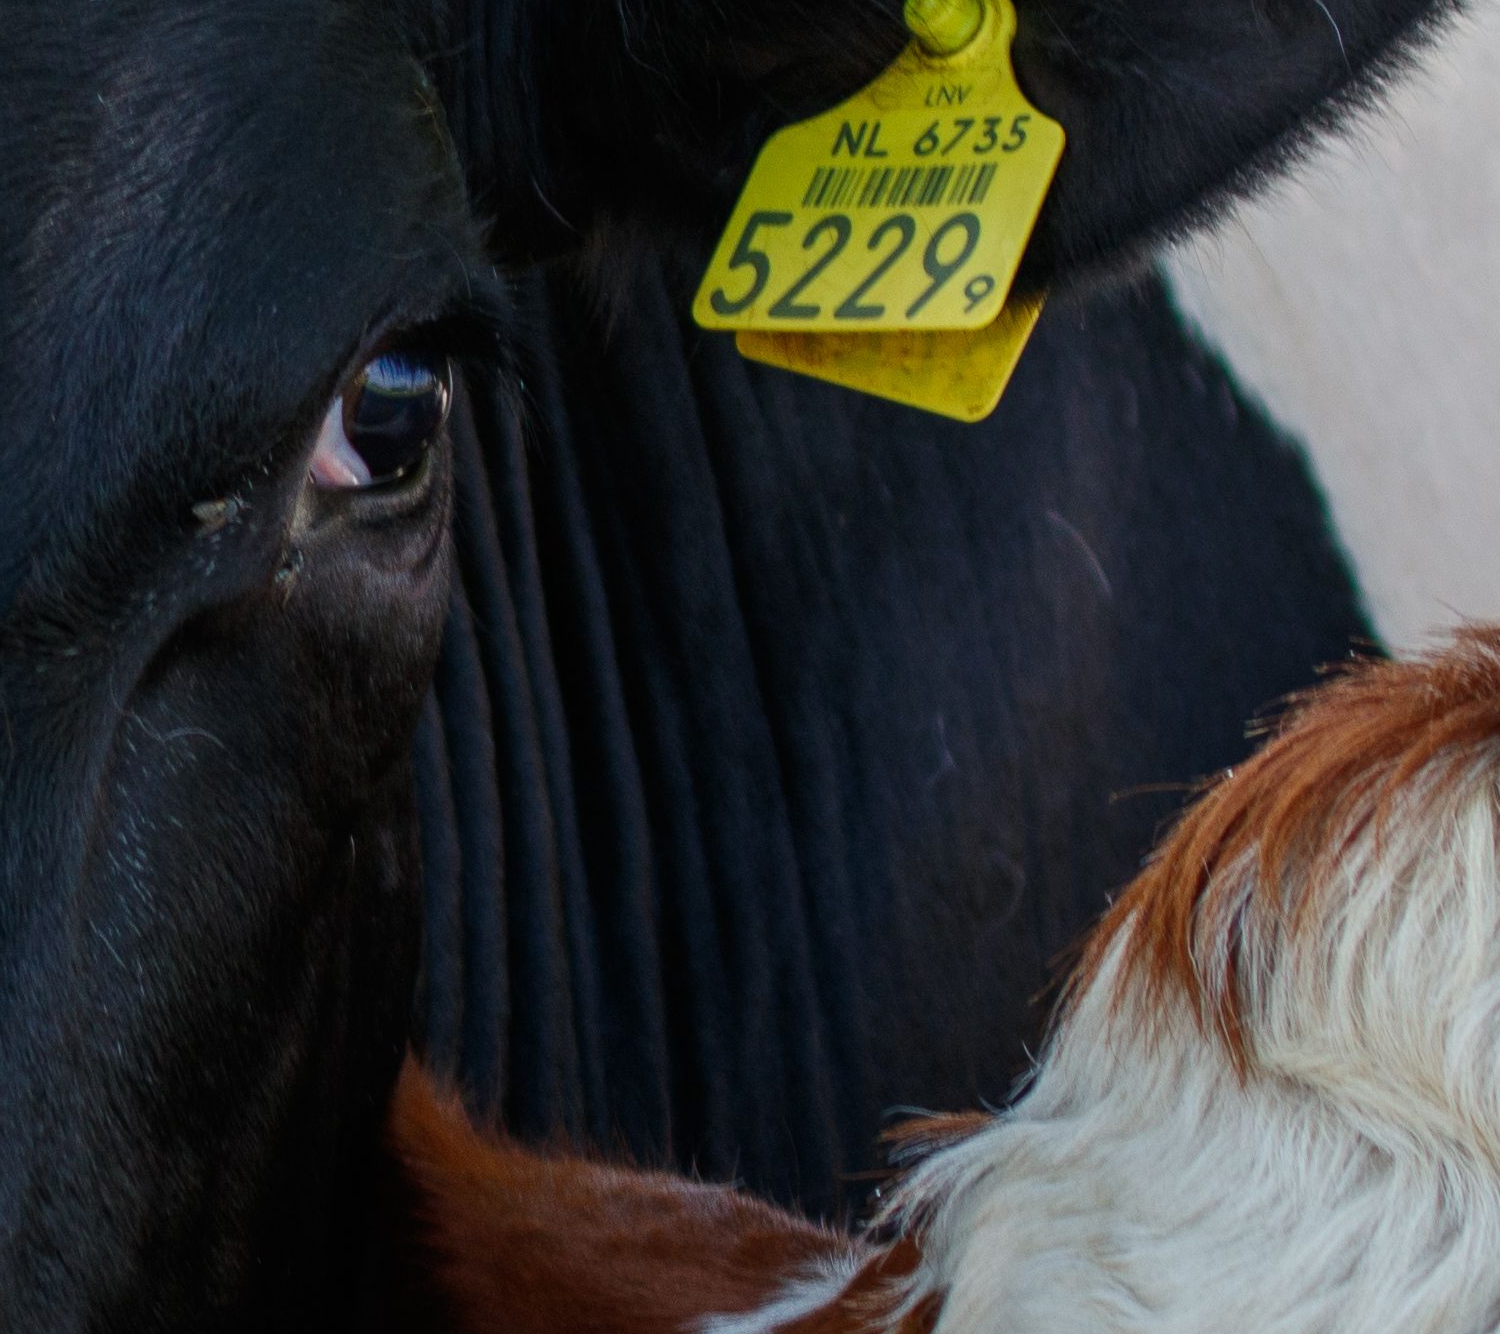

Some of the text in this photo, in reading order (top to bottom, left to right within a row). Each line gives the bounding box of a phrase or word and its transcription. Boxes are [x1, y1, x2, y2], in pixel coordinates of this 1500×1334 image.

[925, 85, 973, 107] LNV
[831, 114, 1030, 157] NL 6735
